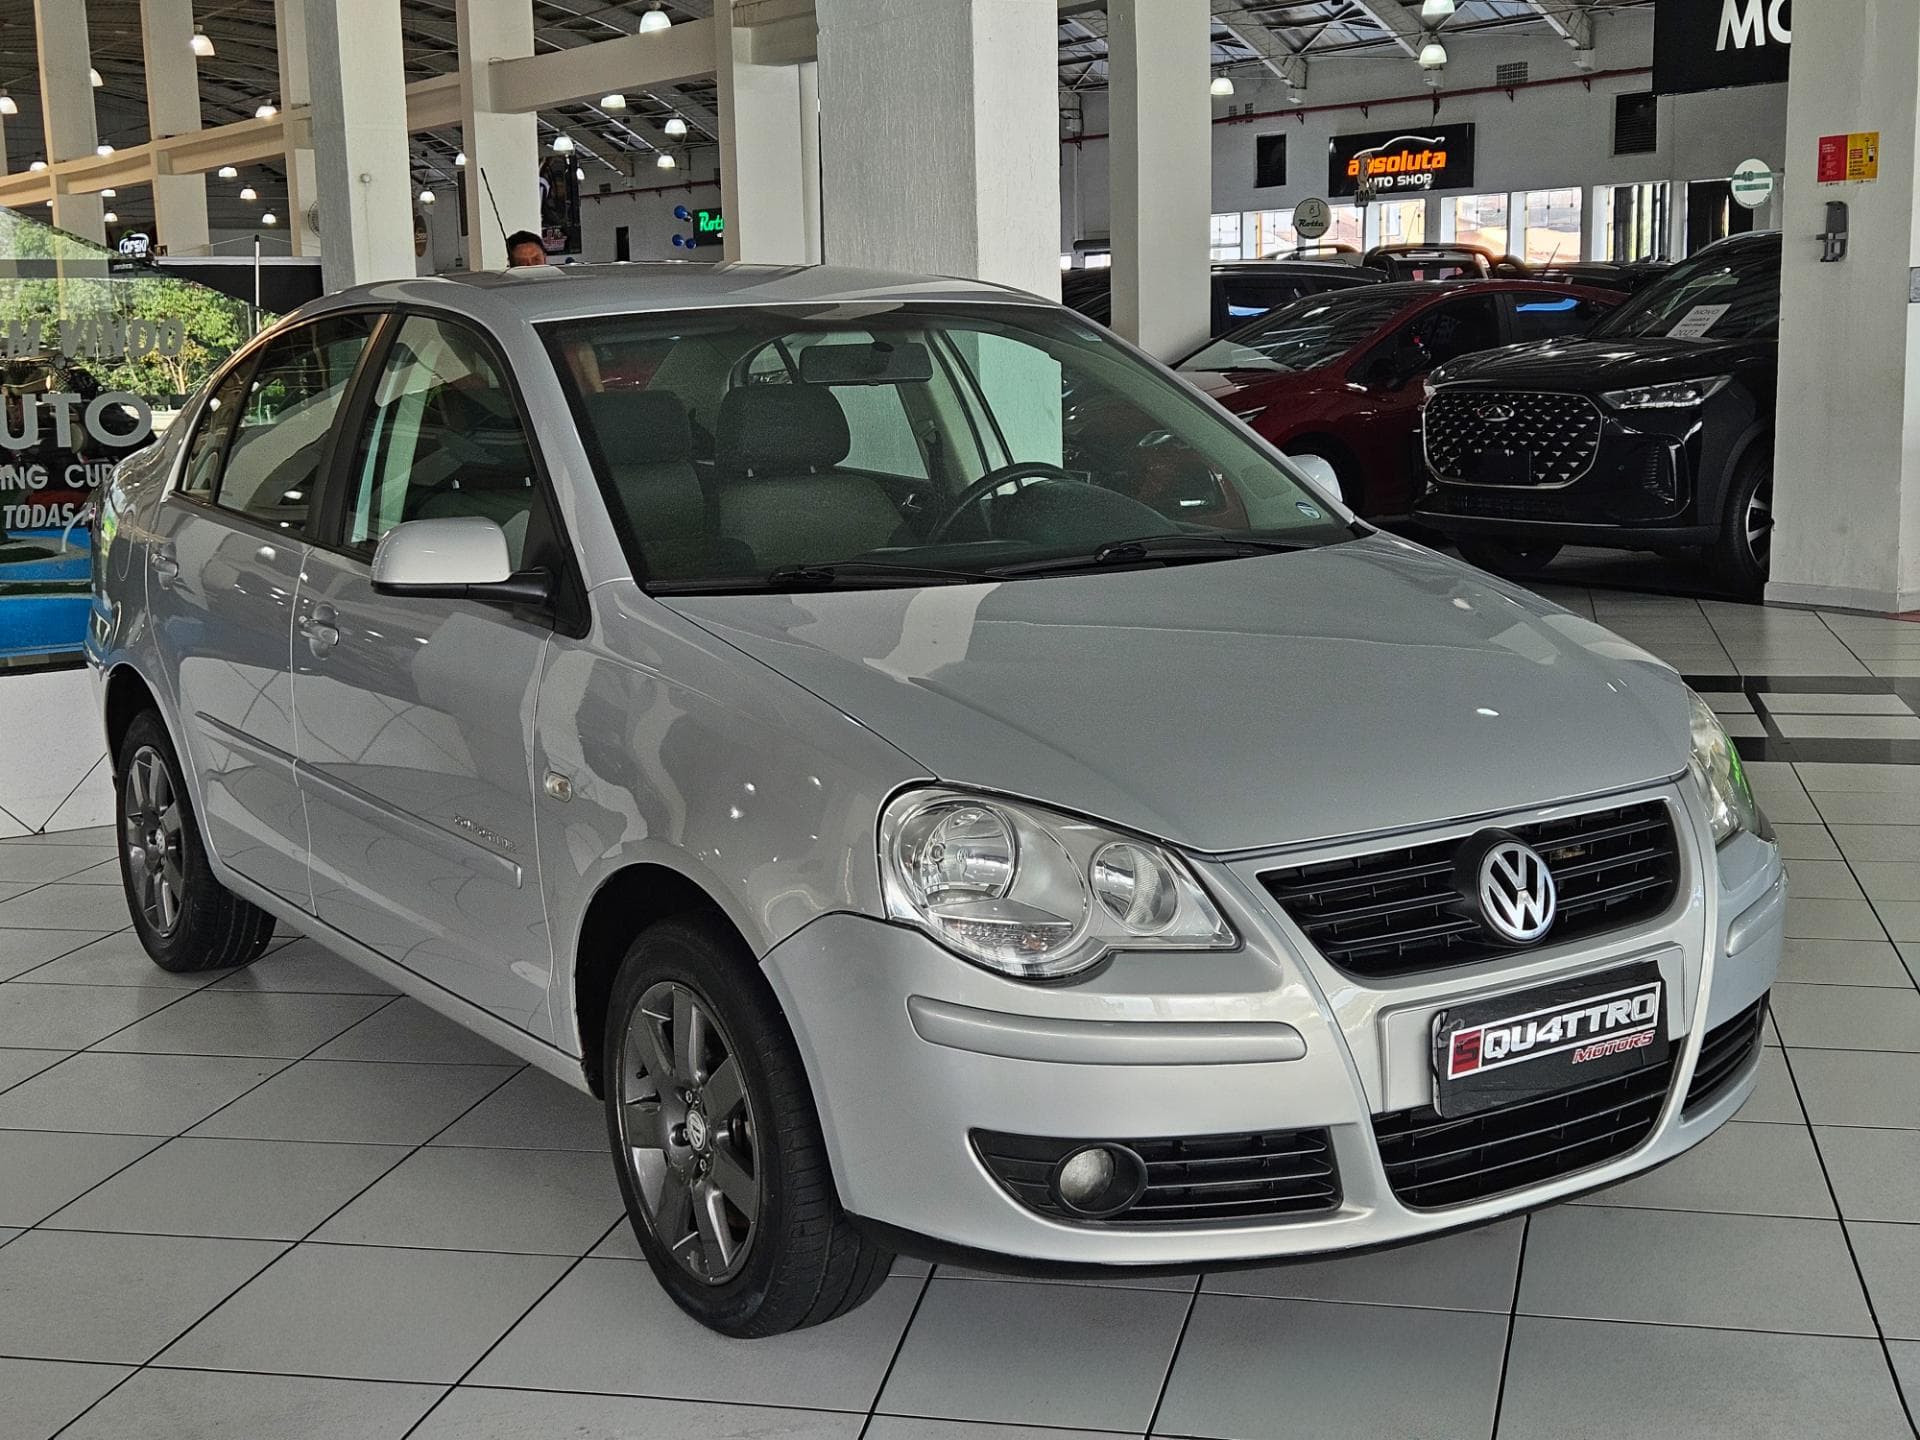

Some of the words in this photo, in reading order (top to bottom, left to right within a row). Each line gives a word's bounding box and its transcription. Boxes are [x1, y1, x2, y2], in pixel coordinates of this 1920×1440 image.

[1364, 176, 1394, 188] UTO
[1397, 173, 1432, 187] SHOP
[59, 317, 184, 357] VINDO
[3, 502, 76, 529] TODAS
[1480, 841, 1556, 941] VW
[1571, 1029, 1656, 1064] MOTORS
